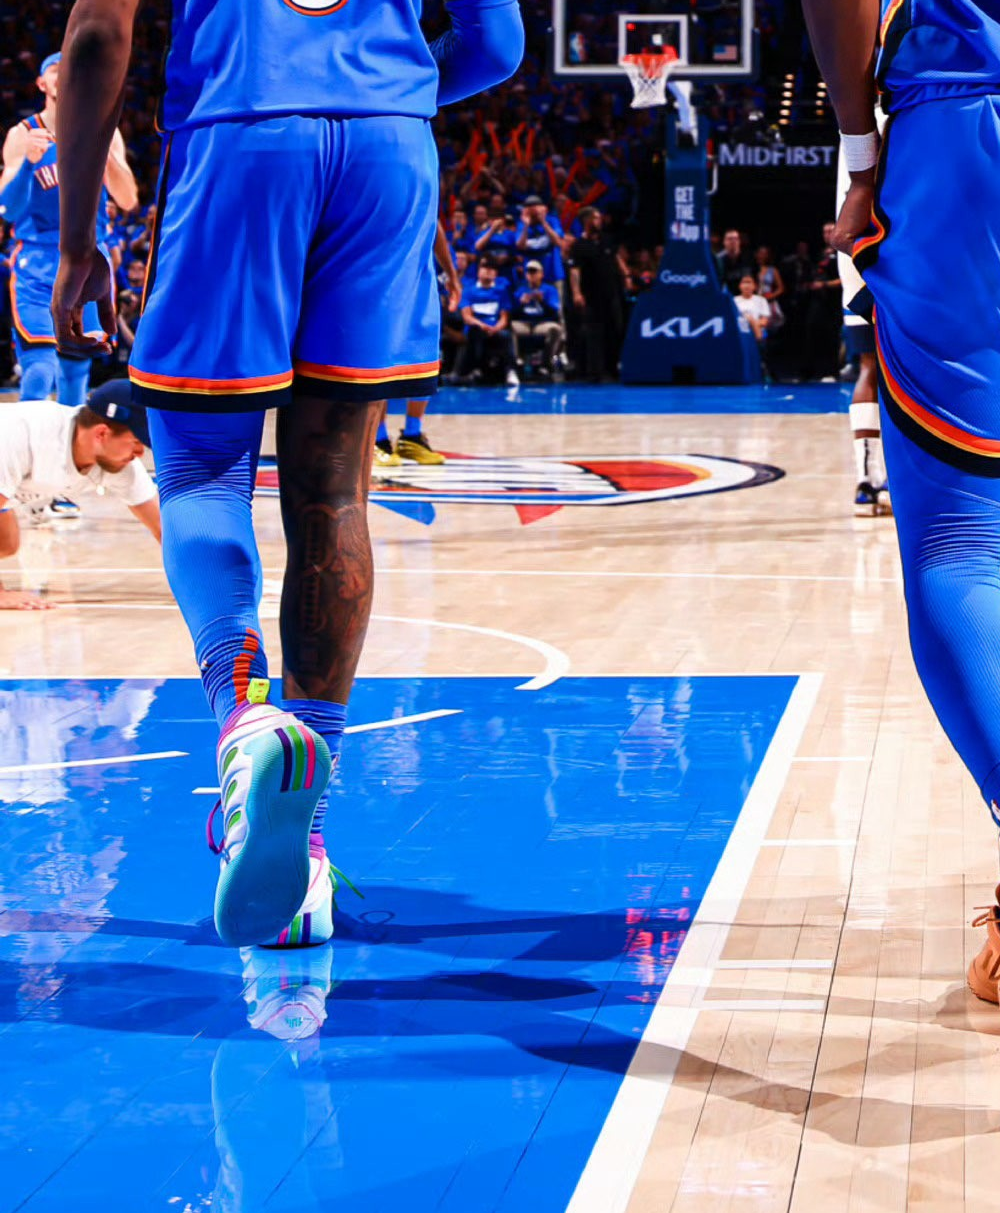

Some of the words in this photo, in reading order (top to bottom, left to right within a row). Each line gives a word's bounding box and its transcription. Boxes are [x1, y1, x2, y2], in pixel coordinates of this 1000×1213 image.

[718, 142, 836, 167] MIDFIRST
[674, 185, 695, 203] GET
[660, 269, 707, 287] Google
[640, 316, 724, 338] KIA
